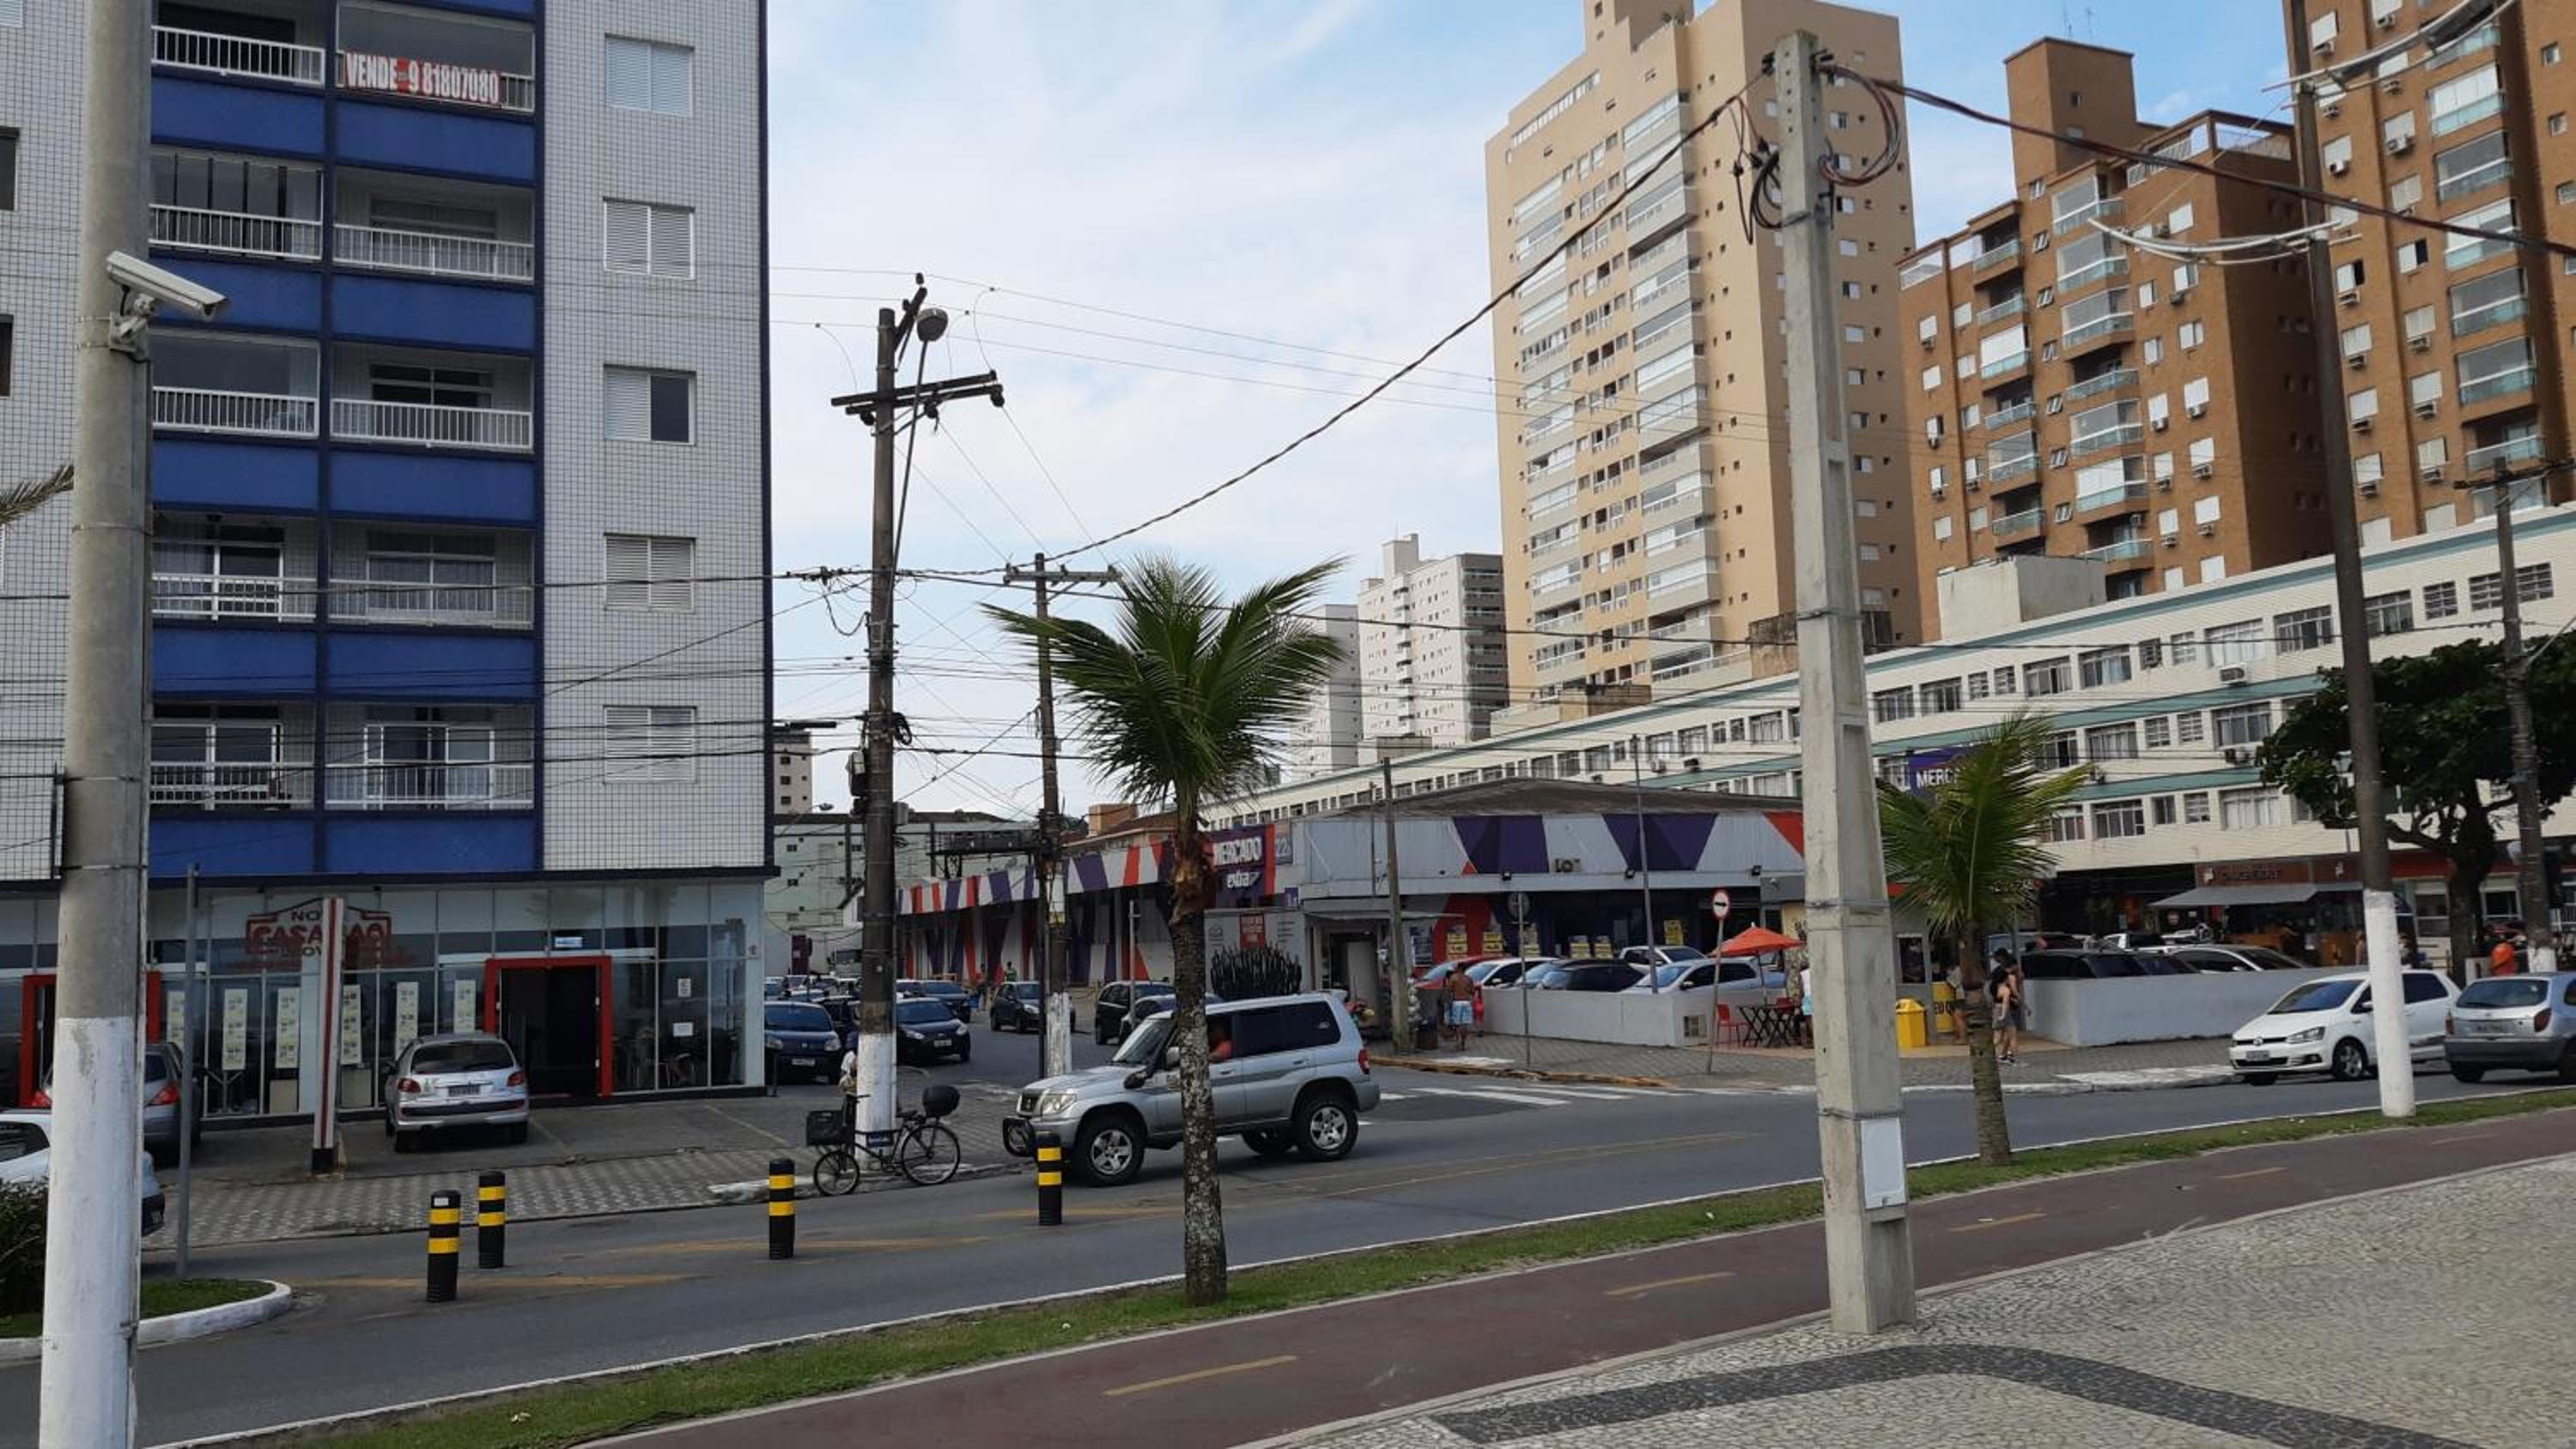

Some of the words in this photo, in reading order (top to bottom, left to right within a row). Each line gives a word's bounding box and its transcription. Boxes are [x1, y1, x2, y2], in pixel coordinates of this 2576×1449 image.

[346, 52, 398, 89] VENDE
[408, 59, 420, 92] 9
[422, 62, 499, 104] 81807080
